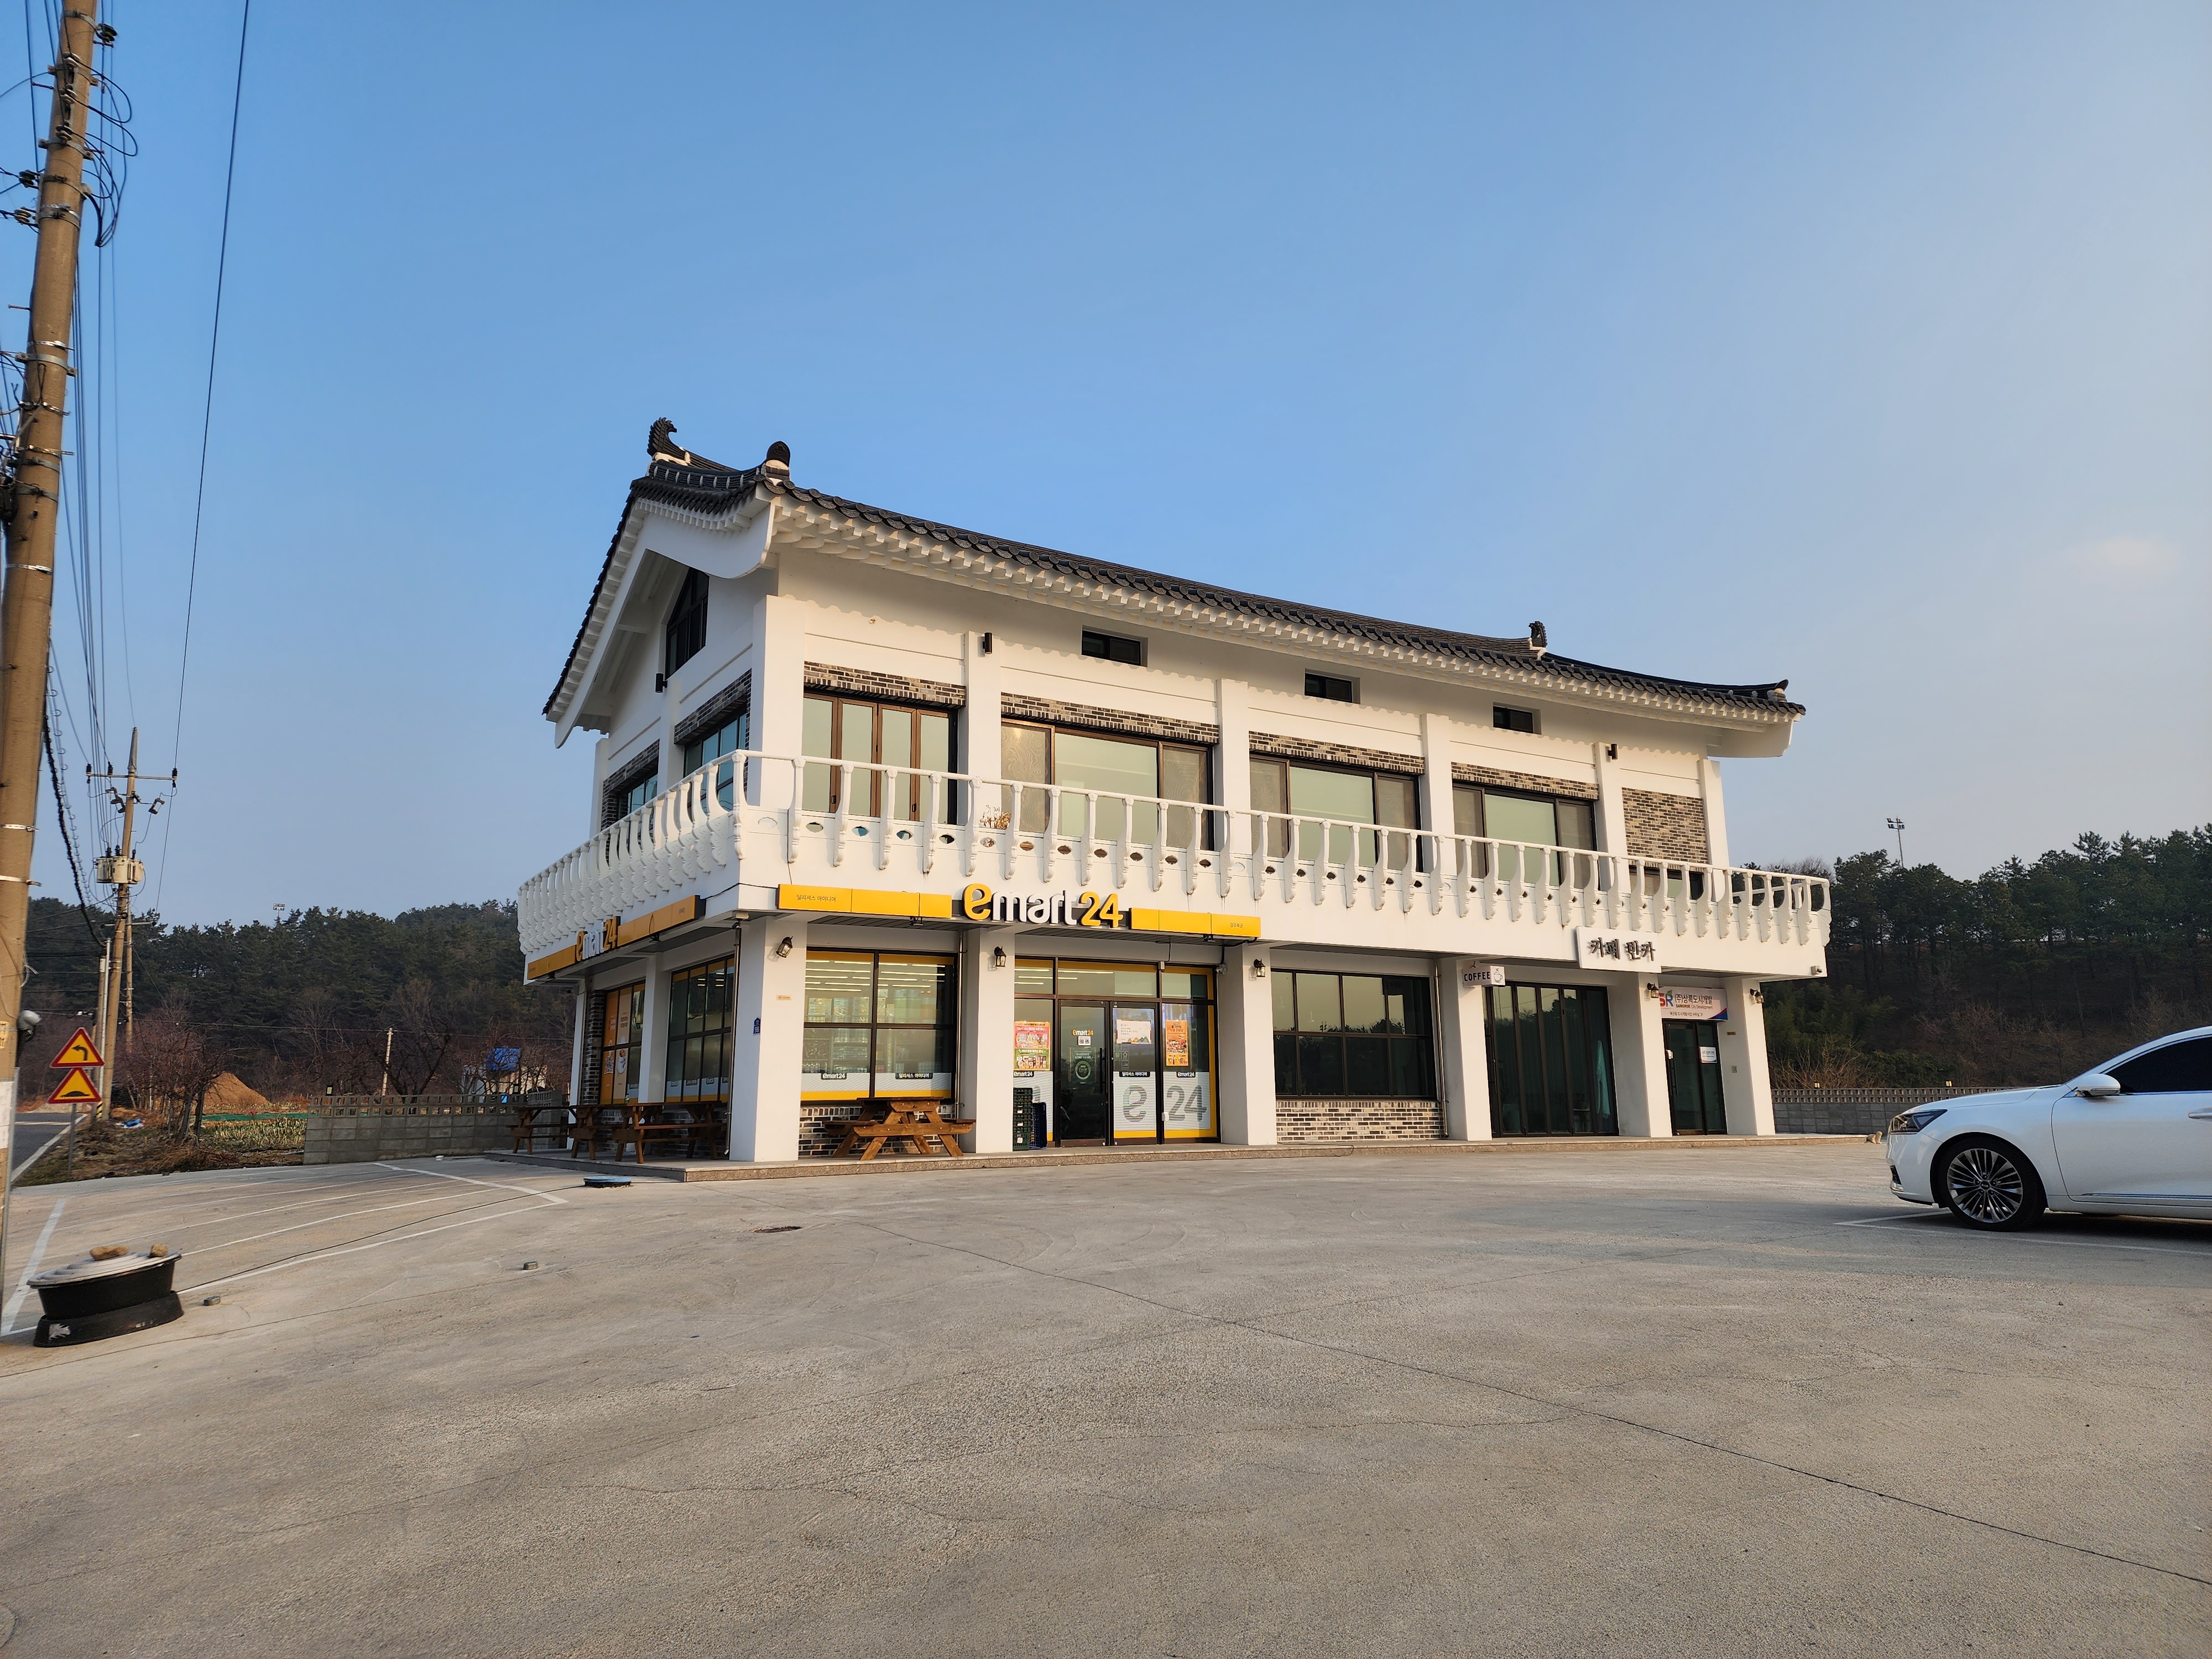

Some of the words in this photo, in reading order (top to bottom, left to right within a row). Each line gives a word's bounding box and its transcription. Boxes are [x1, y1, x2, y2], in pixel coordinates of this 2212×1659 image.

[962, 883, 1124, 928] emart24
[576, 916, 620, 961] emart24
[1590, 937, 1620, 960] 카페
[1625, 940, 1656, 962] 민카
[1464, 971, 1491, 982] COFFEE
[1674, 994, 1713, 1005] (주)상록도시개발
[1166, 1085, 1207, 1122] 24
